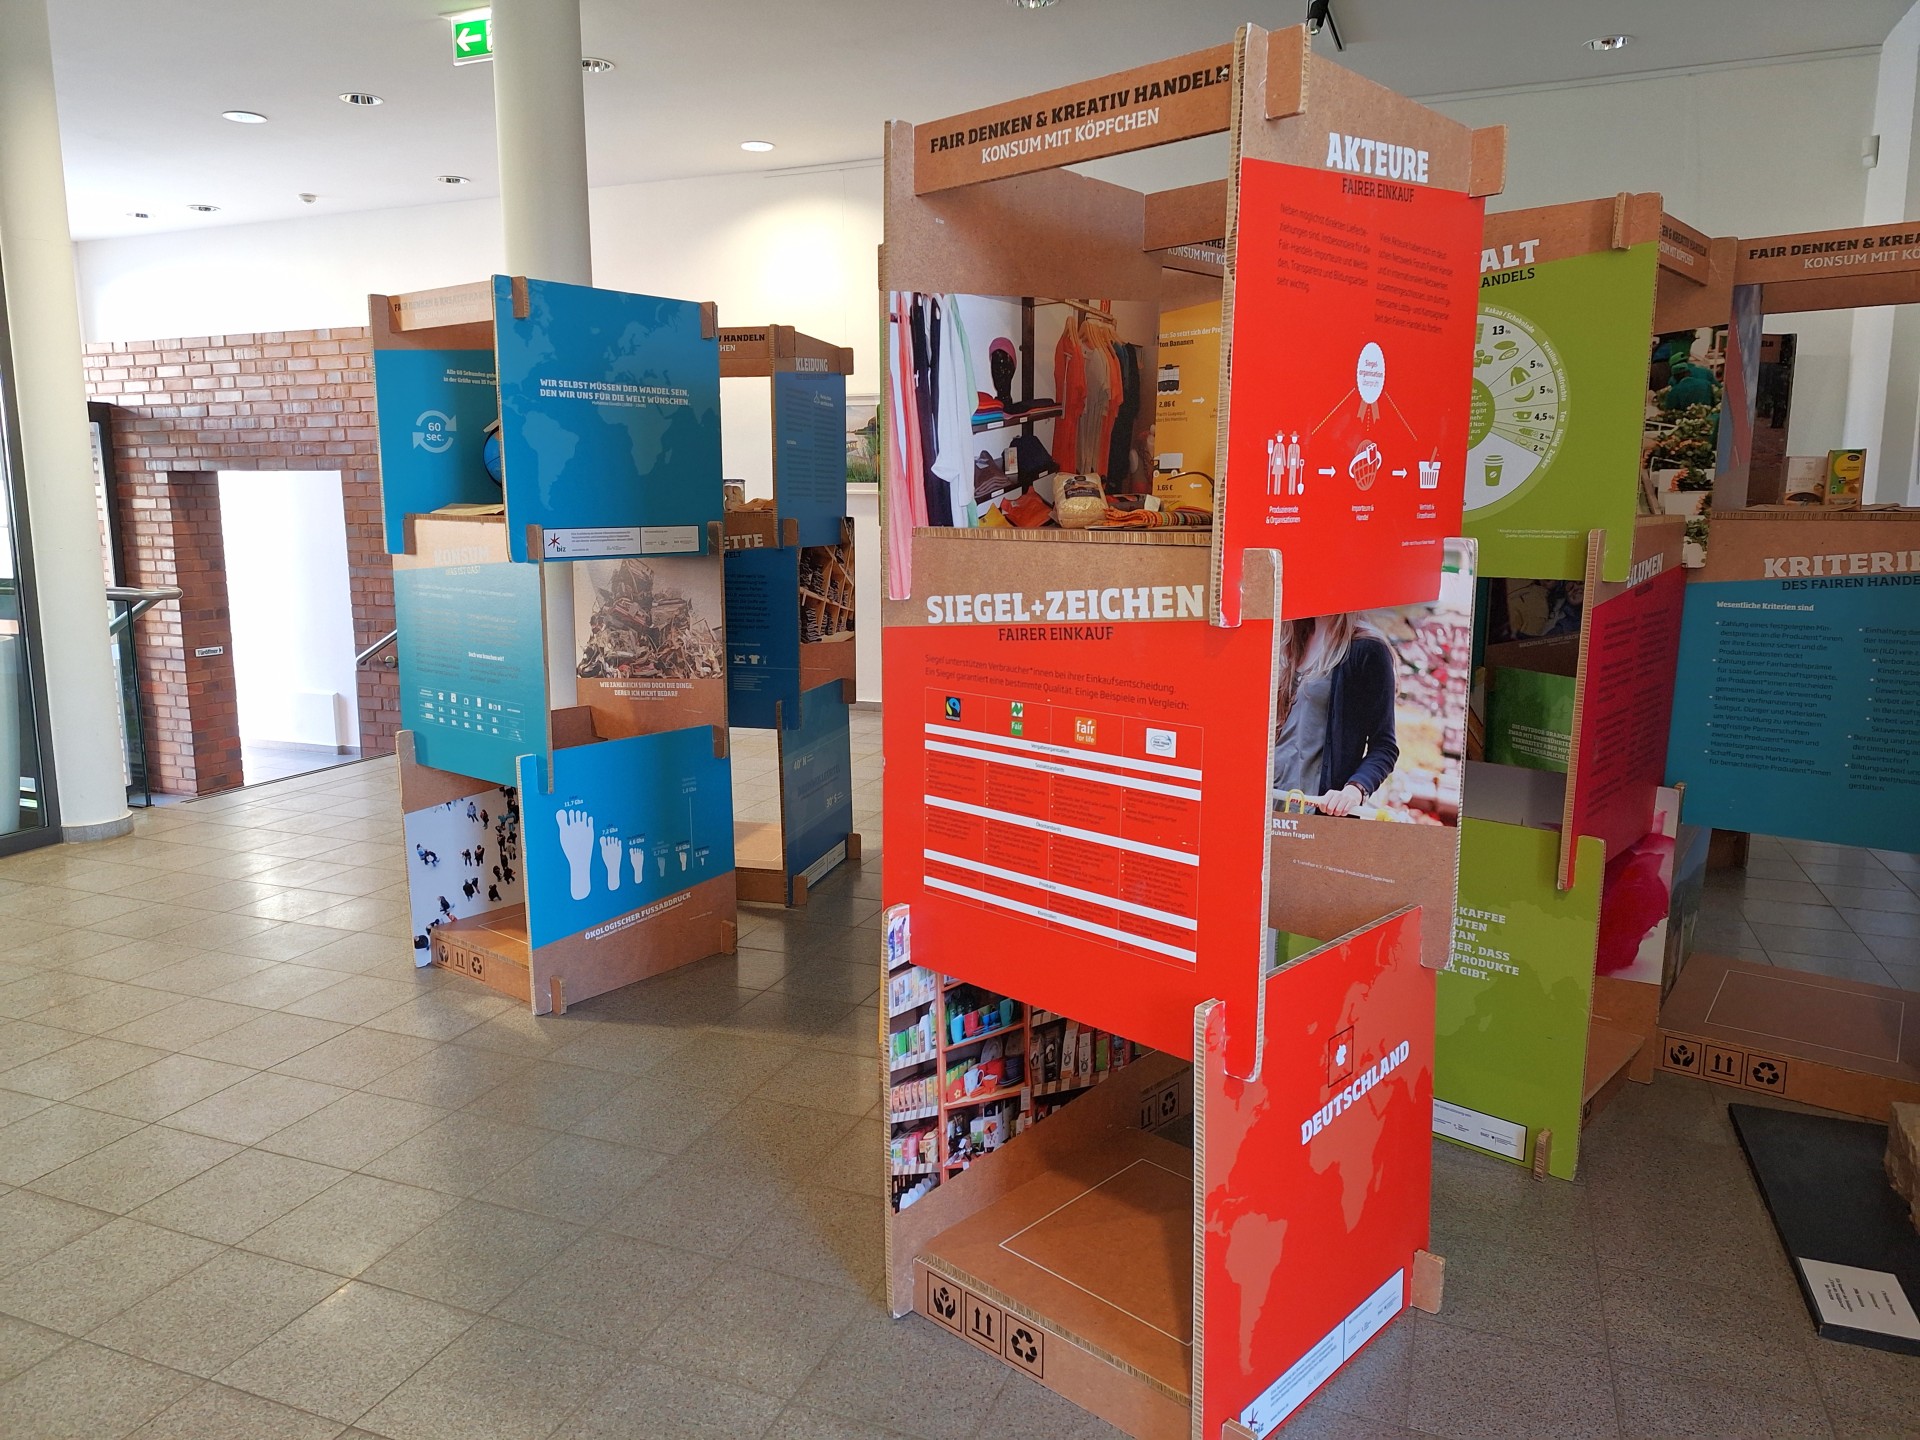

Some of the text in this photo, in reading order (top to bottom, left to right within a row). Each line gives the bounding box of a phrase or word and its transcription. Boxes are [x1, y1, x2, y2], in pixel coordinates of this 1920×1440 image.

[930, 64, 1230, 153] FAIR DENKEN & KREATIV HANDELN
[981, 107, 1160, 164] KONSUM MIT KÖPFCHEN
[1326, 132, 1428, 184] AKTEURE
[1342, 178, 1414, 202] FAIRER EINKAUF
[1202, 250, 1215, 264] MIT
[1480, 239, 1540, 273] ALT
[1749, 246, 1786, 260] FAIR
[1790, 239, 1858, 256] DENKEN
[1862, 238, 1874, 248] &
[1804, 254, 1866, 268] KONSUM
[1870, 250, 1898, 262] MIT
[1485, 306, 1502, 316] Kakao
[1506, 312, 1534, 334] Schokolade
[724, 334, 766, 342] HANDELN
[1542, 340, 1558, 366] Textilien
[795, 358, 828, 372] KLEIDUNG
[540, 378, 690, 397] WIR SELBST MÜSSEN DER WANDEL SEIN,
[540, 388, 557, 397] DEN
[558, 390, 576, 398] WIR
[576, 392, 593, 400] UNS
[594, 392, 611, 401] FÜR
[612, 394, 625, 402] DIE
[626, 394, 646, 404] WELT
[648, 395, 690, 406] WÜNSCHEN.
[428, 422, 440, 432] 60
[426, 432, 444, 442] sec.
[1541, 448, 1555, 468] Zucker
[1782, 576, 1920, 590] DES FAIREN HANDE
[926, 584, 1204, 624] SIEGEL+ZEICHEN
[1716, 601, 1814, 612] Wesentliche Kriterien sind
[998, 626, 1114, 641] FAIRER EINKAUF
[1722, 620, 1748, 629] Zahlung
[925, 654, 945, 665] Siegel
[946, 658, 988, 670] unterstützen
[1054, 670, 1066, 679] bei
[1067, 672, 1085, 682] ihrer
[925, 667, 1190, 710] Ein Siegel garantiert eine bestimmte Qualität. Einige Beispiele im Vergleich:
[1076, 720, 1095, 734] fair
[1086, 735, 1094, 743] life
[1272, 818, 1298, 830] RKT
[1293, 832, 1314, 840] fragen!
[1038, 881, 1056, 890] Produkte
[585, 892, 692, 940] ÖKOLOGISCHER FUSSABDRUCK
[1478, 946, 1510, 961] DASS
[1454, 953, 1520, 976] PRODUKTE
[1460, 966, 1490, 980] GIBT.
[1302, 1040, 1410, 1146] DEUTSCHLAND
